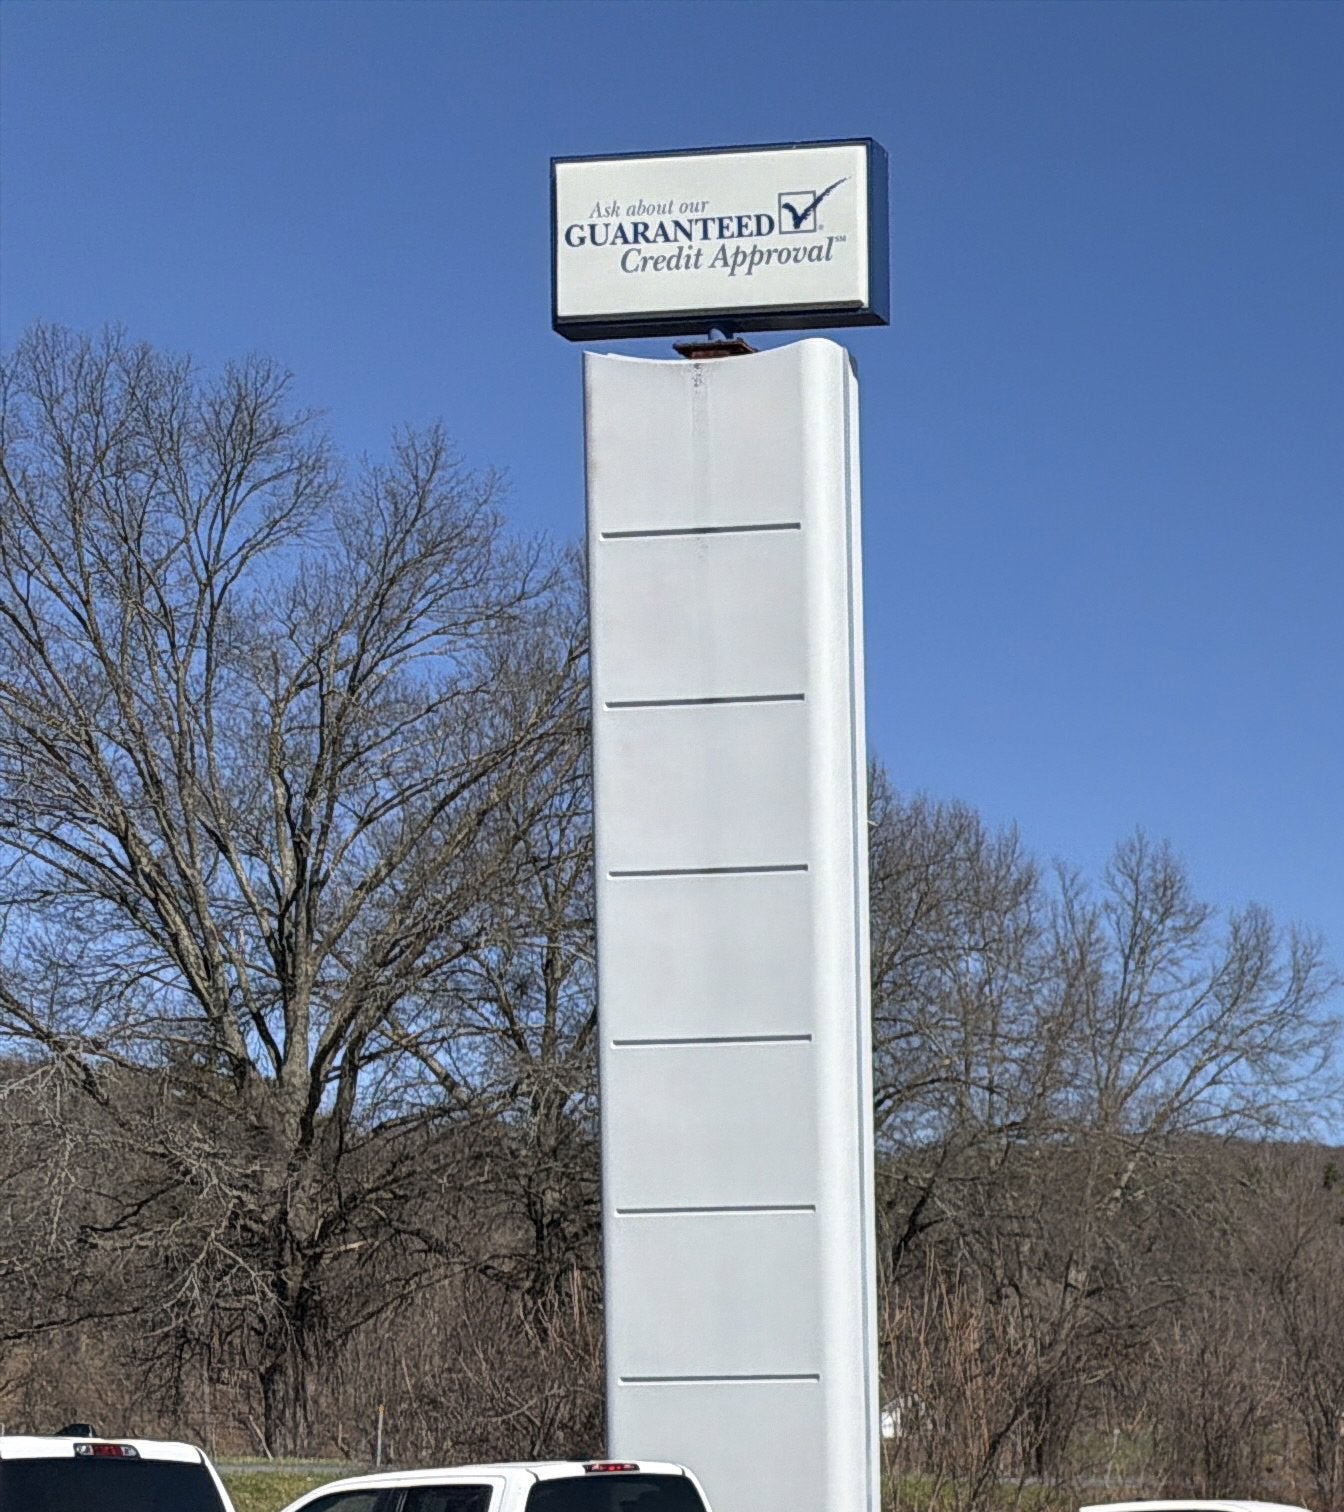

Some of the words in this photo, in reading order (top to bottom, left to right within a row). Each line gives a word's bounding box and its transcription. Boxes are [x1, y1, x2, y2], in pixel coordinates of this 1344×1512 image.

[589, 200, 620, 219] Ask
[626, 199, 674, 217] about
[679, 200, 710, 214] our
[564, 213, 775, 248] GUARANTEED
[620, 244, 703, 273] Credit
